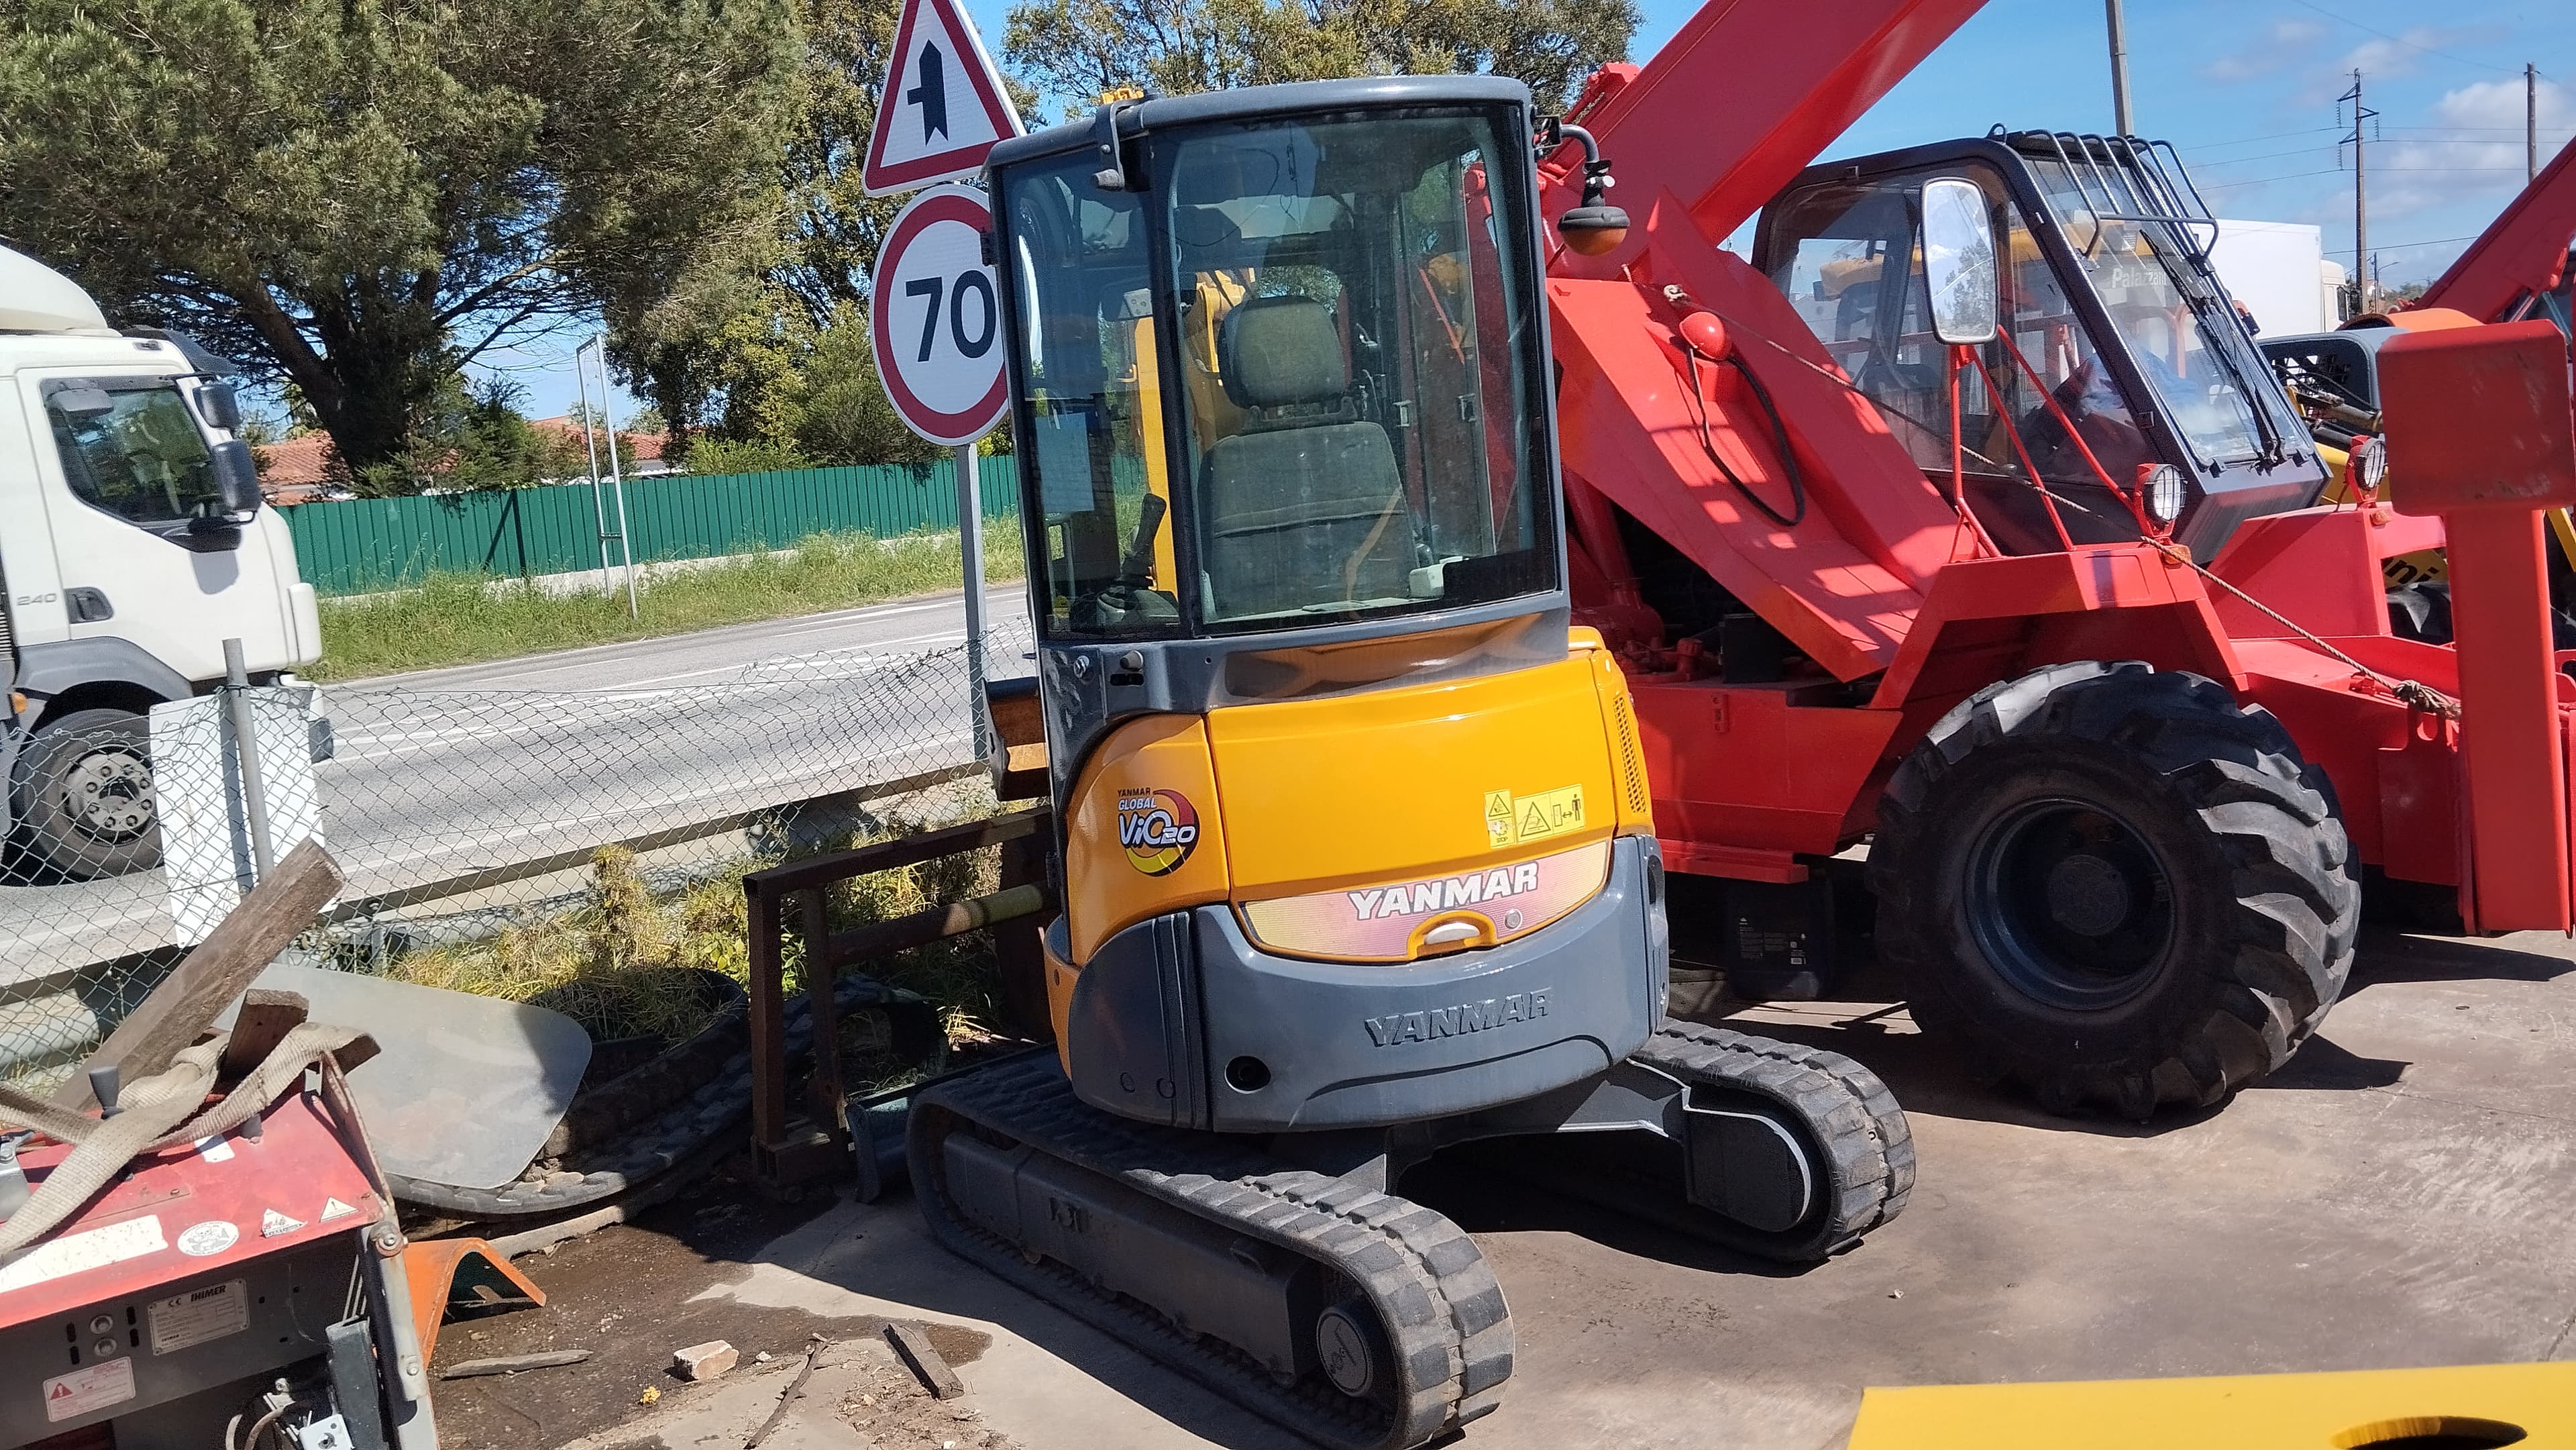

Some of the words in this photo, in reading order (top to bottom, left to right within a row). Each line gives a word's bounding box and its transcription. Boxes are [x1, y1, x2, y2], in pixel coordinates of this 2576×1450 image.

[906, 270, 996, 362] 70
[2380, 558, 2439, 584] ni
[17, 593, 56, 605] 240
[1118, 787, 1151, 797] YANMAR
[1118, 797, 1157, 811] GLOBAL
[1348, 861, 1538, 921] YANMAR
[1364, 987, 1551, 1047] YANMAR
